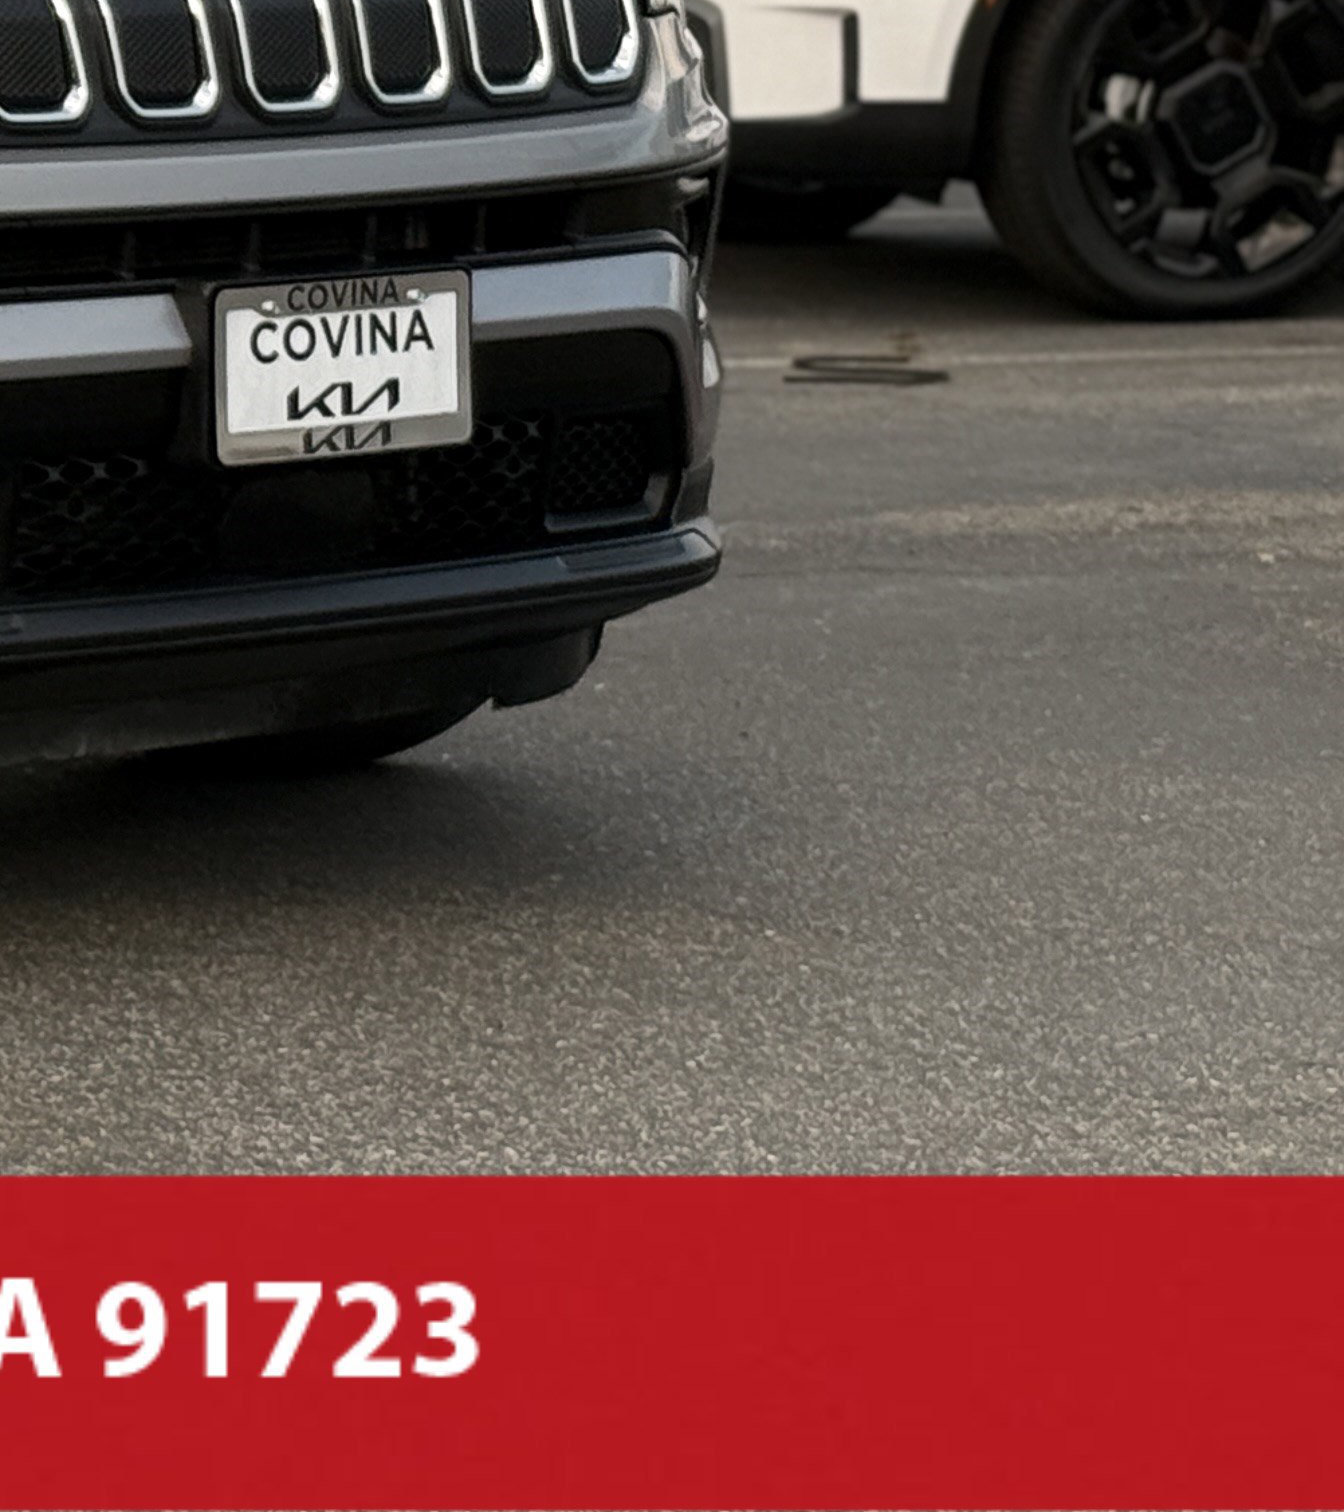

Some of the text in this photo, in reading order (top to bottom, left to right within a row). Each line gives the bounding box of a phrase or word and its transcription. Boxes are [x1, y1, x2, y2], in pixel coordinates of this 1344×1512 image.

[287, 278, 399, 311] COVINA
[250, 309, 434, 364] COVINA
[287, 377, 400, 421] KIA
